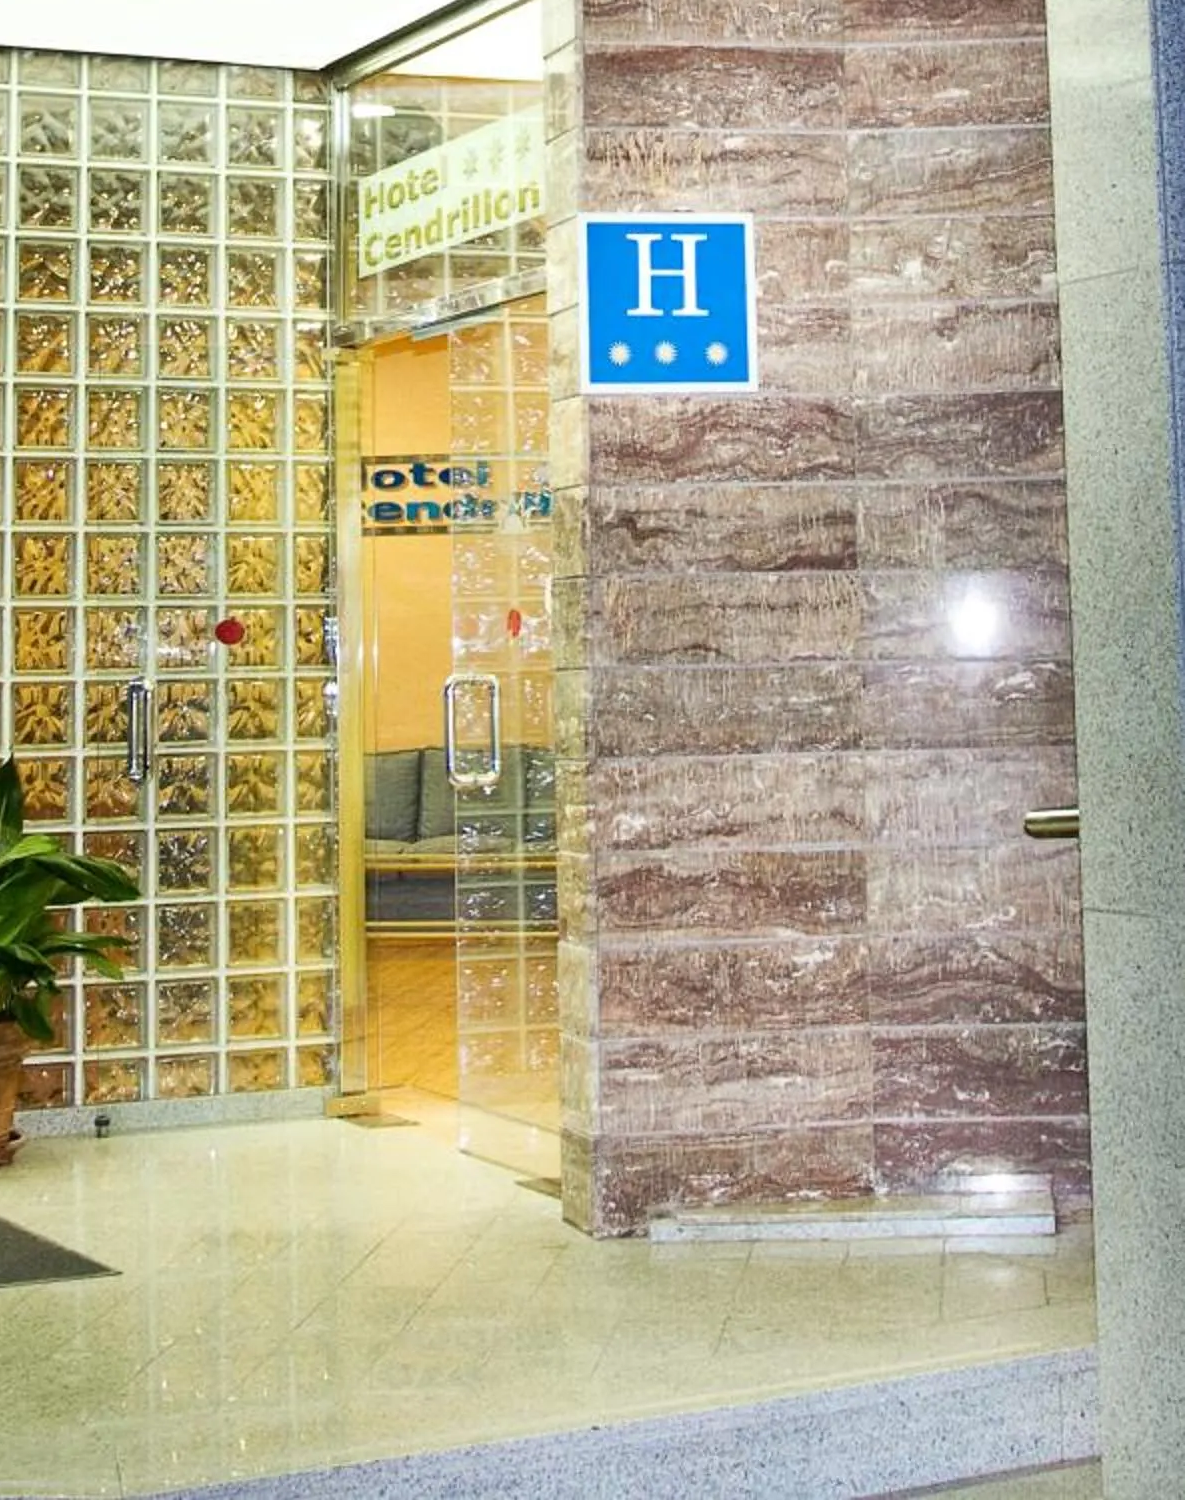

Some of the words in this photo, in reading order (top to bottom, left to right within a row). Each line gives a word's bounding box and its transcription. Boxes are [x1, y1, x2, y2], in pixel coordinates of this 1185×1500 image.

[364, 155, 448, 218] Hotel
[364, 181, 539, 266] Cendrillon
[626, 233, 710, 317] H
[361, 461, 488, 493] otel
